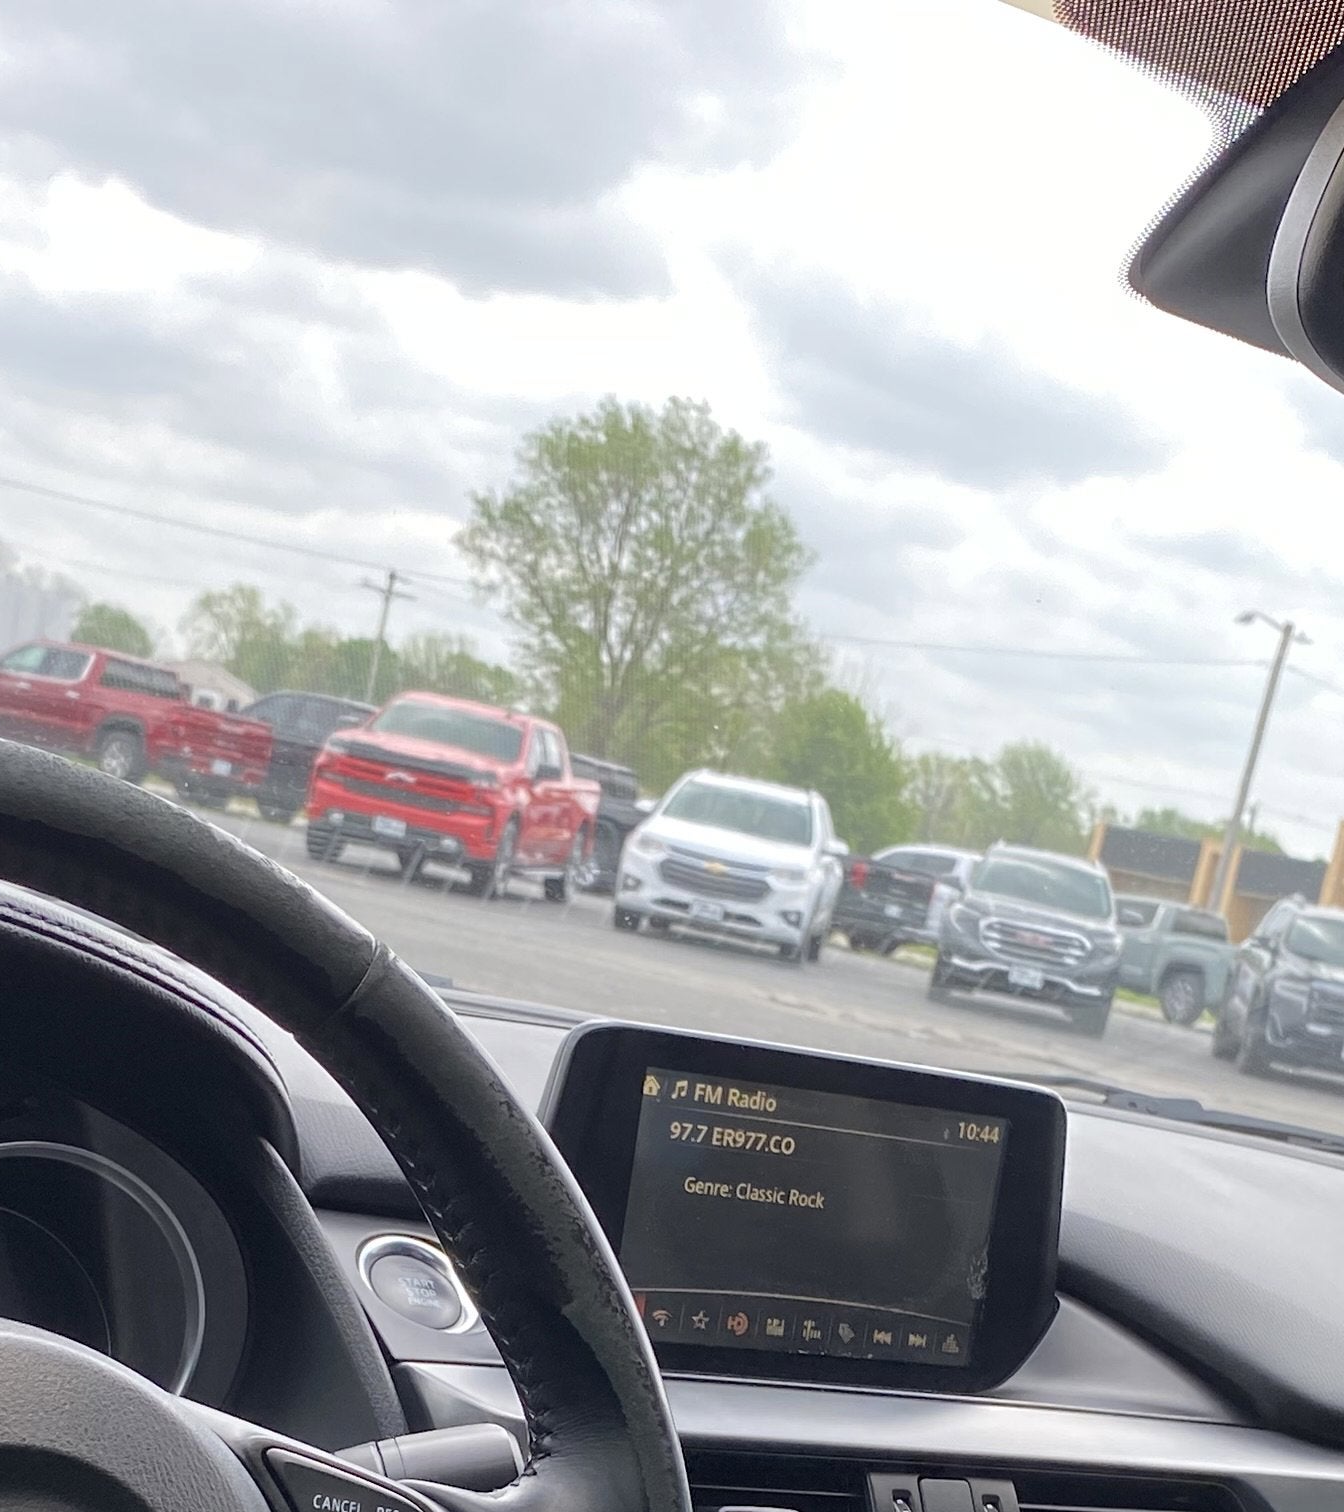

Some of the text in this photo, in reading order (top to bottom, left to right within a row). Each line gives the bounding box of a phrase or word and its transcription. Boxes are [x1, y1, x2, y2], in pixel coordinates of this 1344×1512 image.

[694, 1083, 777, 1112] FM Radio
[670, 1122, 795, 1155] 97.7 ER977.CO
[959, 1121, 1000, 1144] 10:44
[684, 1177, 824, 1209] Genre: Classic Rock
